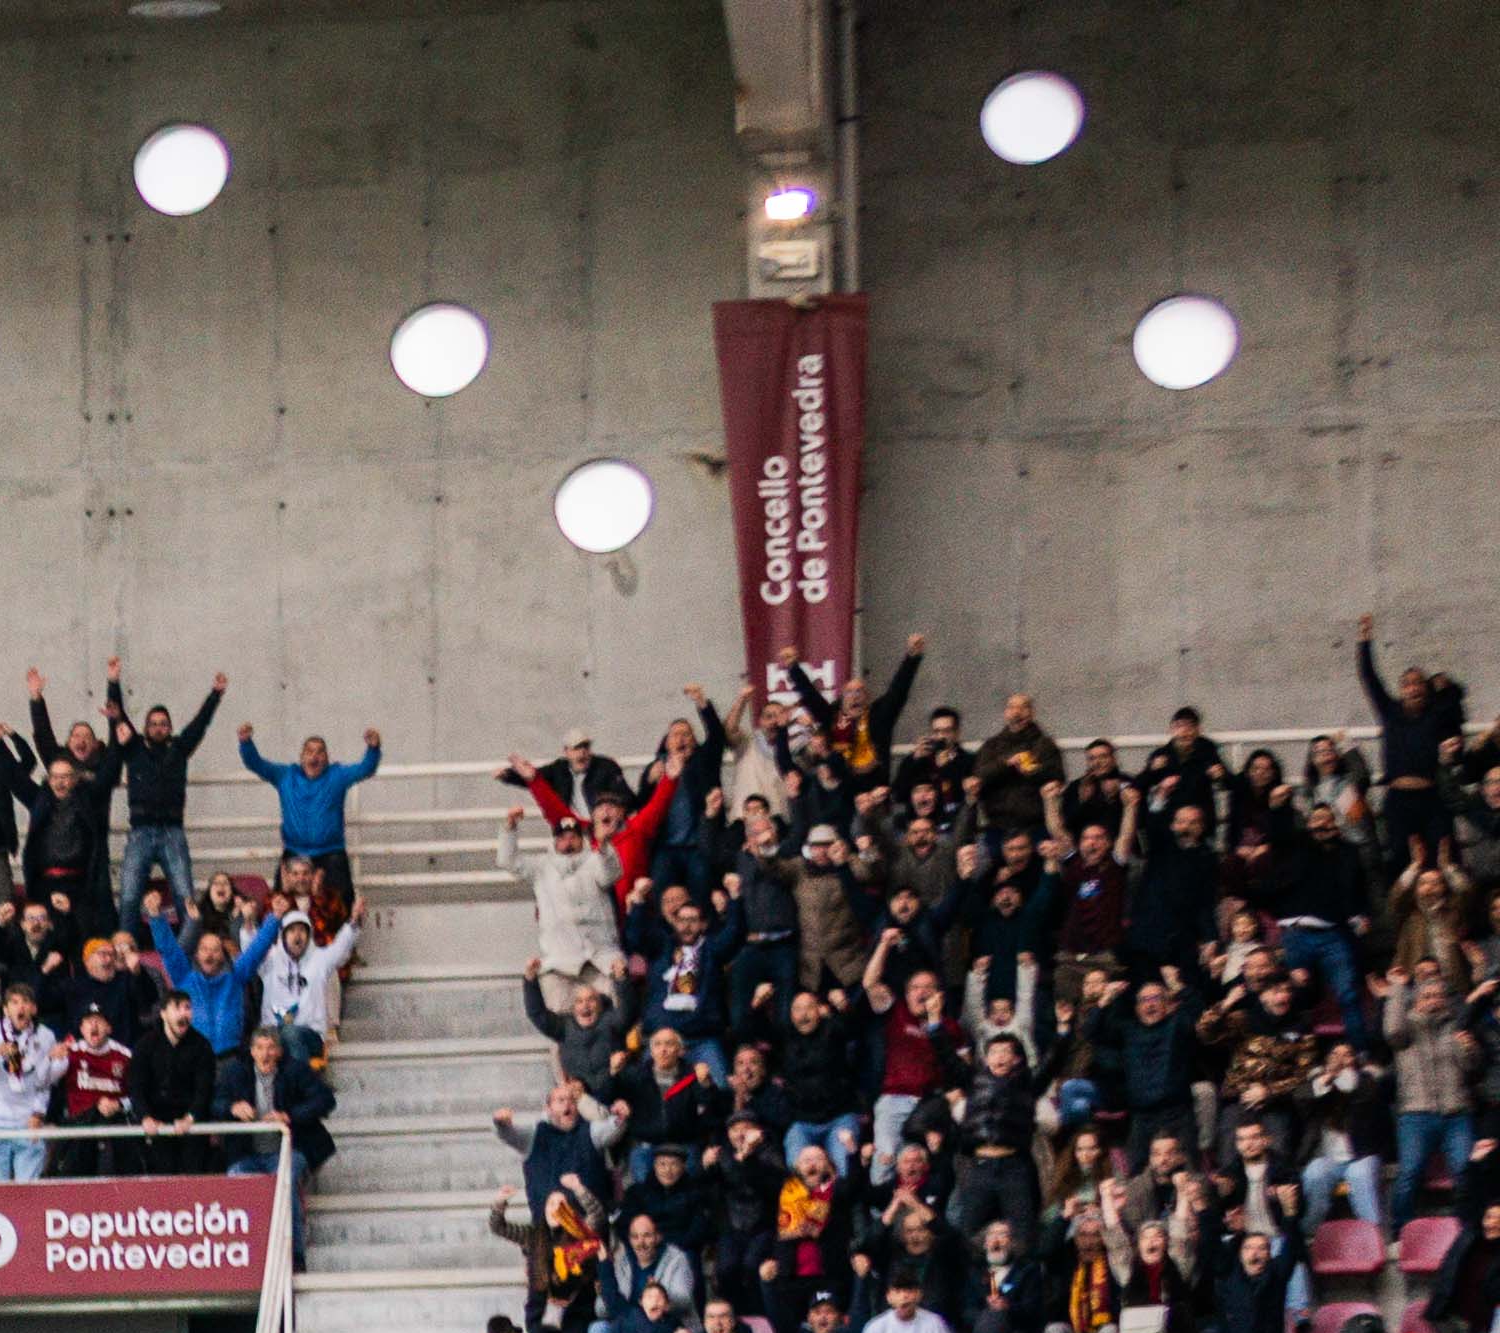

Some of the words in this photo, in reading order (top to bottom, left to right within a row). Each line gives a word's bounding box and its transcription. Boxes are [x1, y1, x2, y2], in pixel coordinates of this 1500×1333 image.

[792, 353, 826, 551] Pontevedra
[760, 454, 791, 604] Concello
[797, 557, 828, 602] de
[45, 1203, 249, 1243] Deputación
[46, 1240, 250, 1272] Pontevedra
